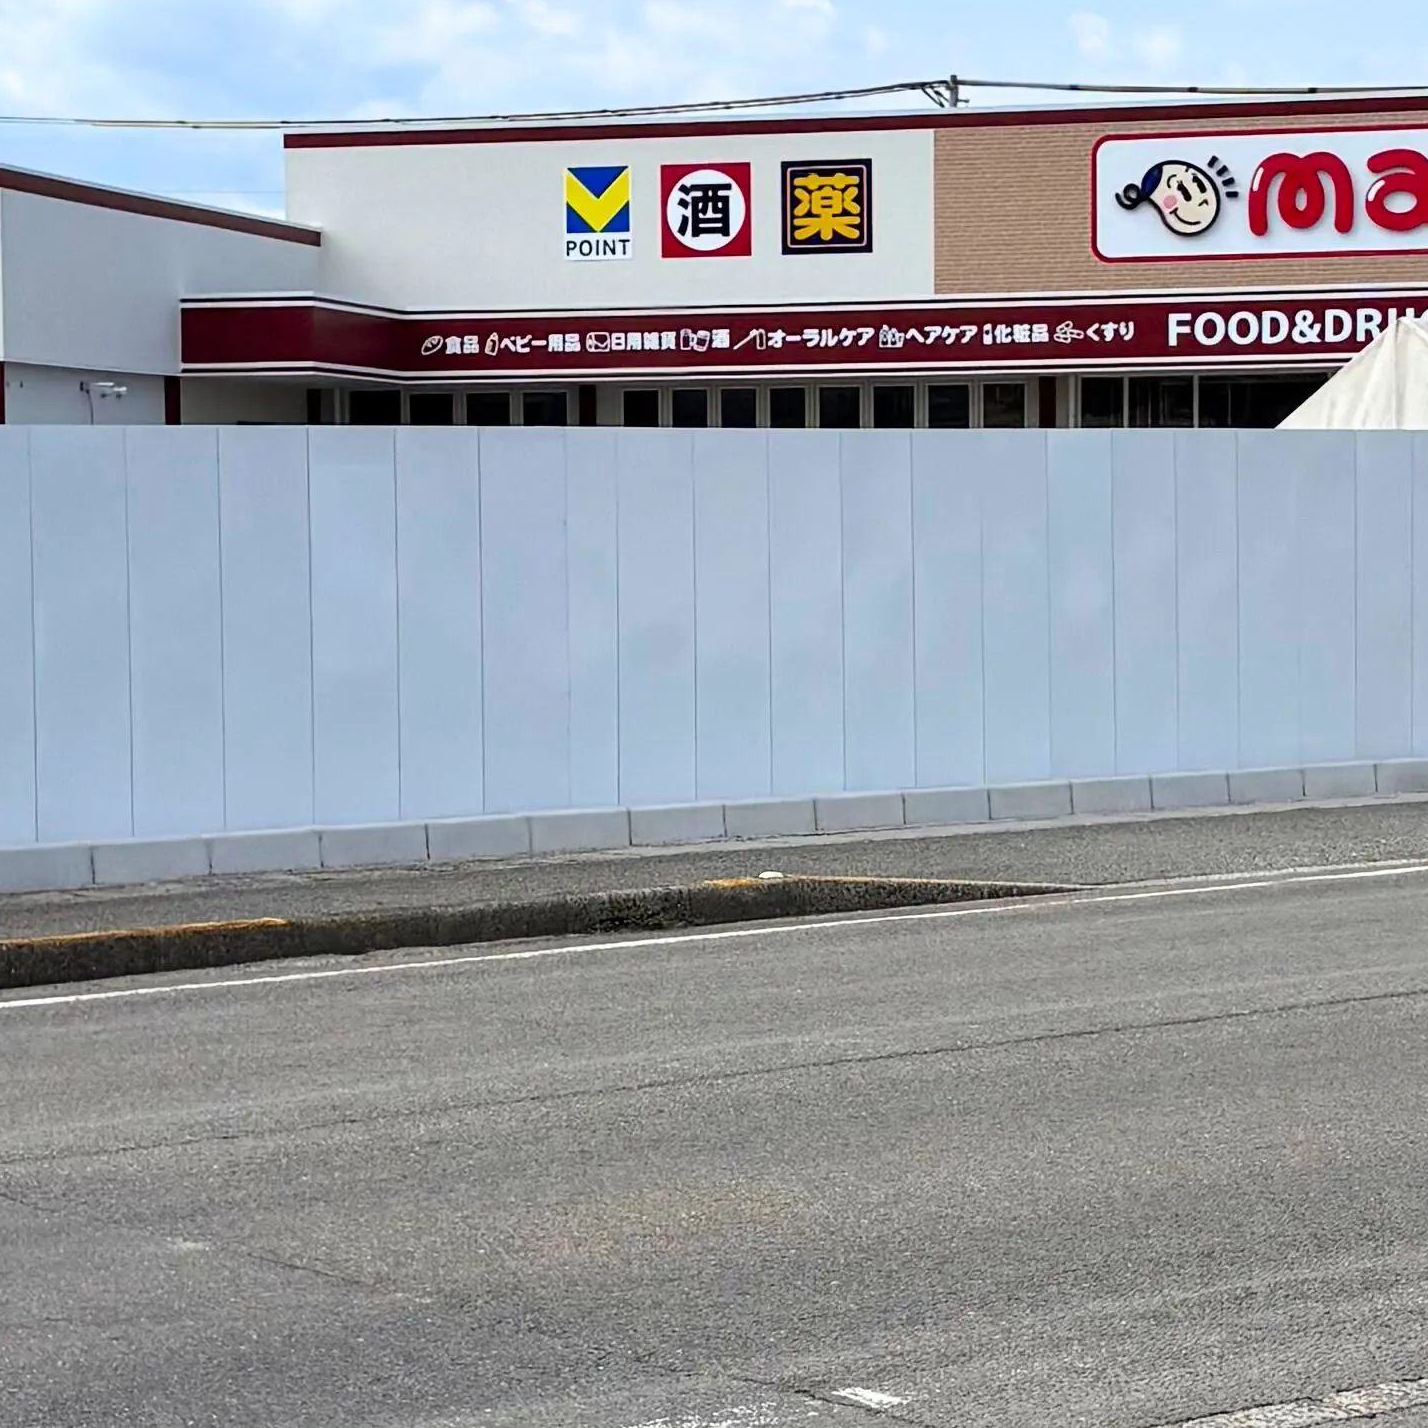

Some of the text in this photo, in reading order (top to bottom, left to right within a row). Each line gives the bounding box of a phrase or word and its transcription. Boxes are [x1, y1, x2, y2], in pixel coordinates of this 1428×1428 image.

[677, 183, 731, 238] 酒
[793, 172, 860, 241] 薬
[566, 239, 630, 256] POINT
[445, 336, 479, 354] 食品
[500, 333, 581, 353] ベビー用品
[767, 327, 875, 348] オーラルケア
[906, 325, 978, 345] ヘアケア
[994, 323, 1049, 344] 化粧品
[1086, 321, 1134, 341] くすり
